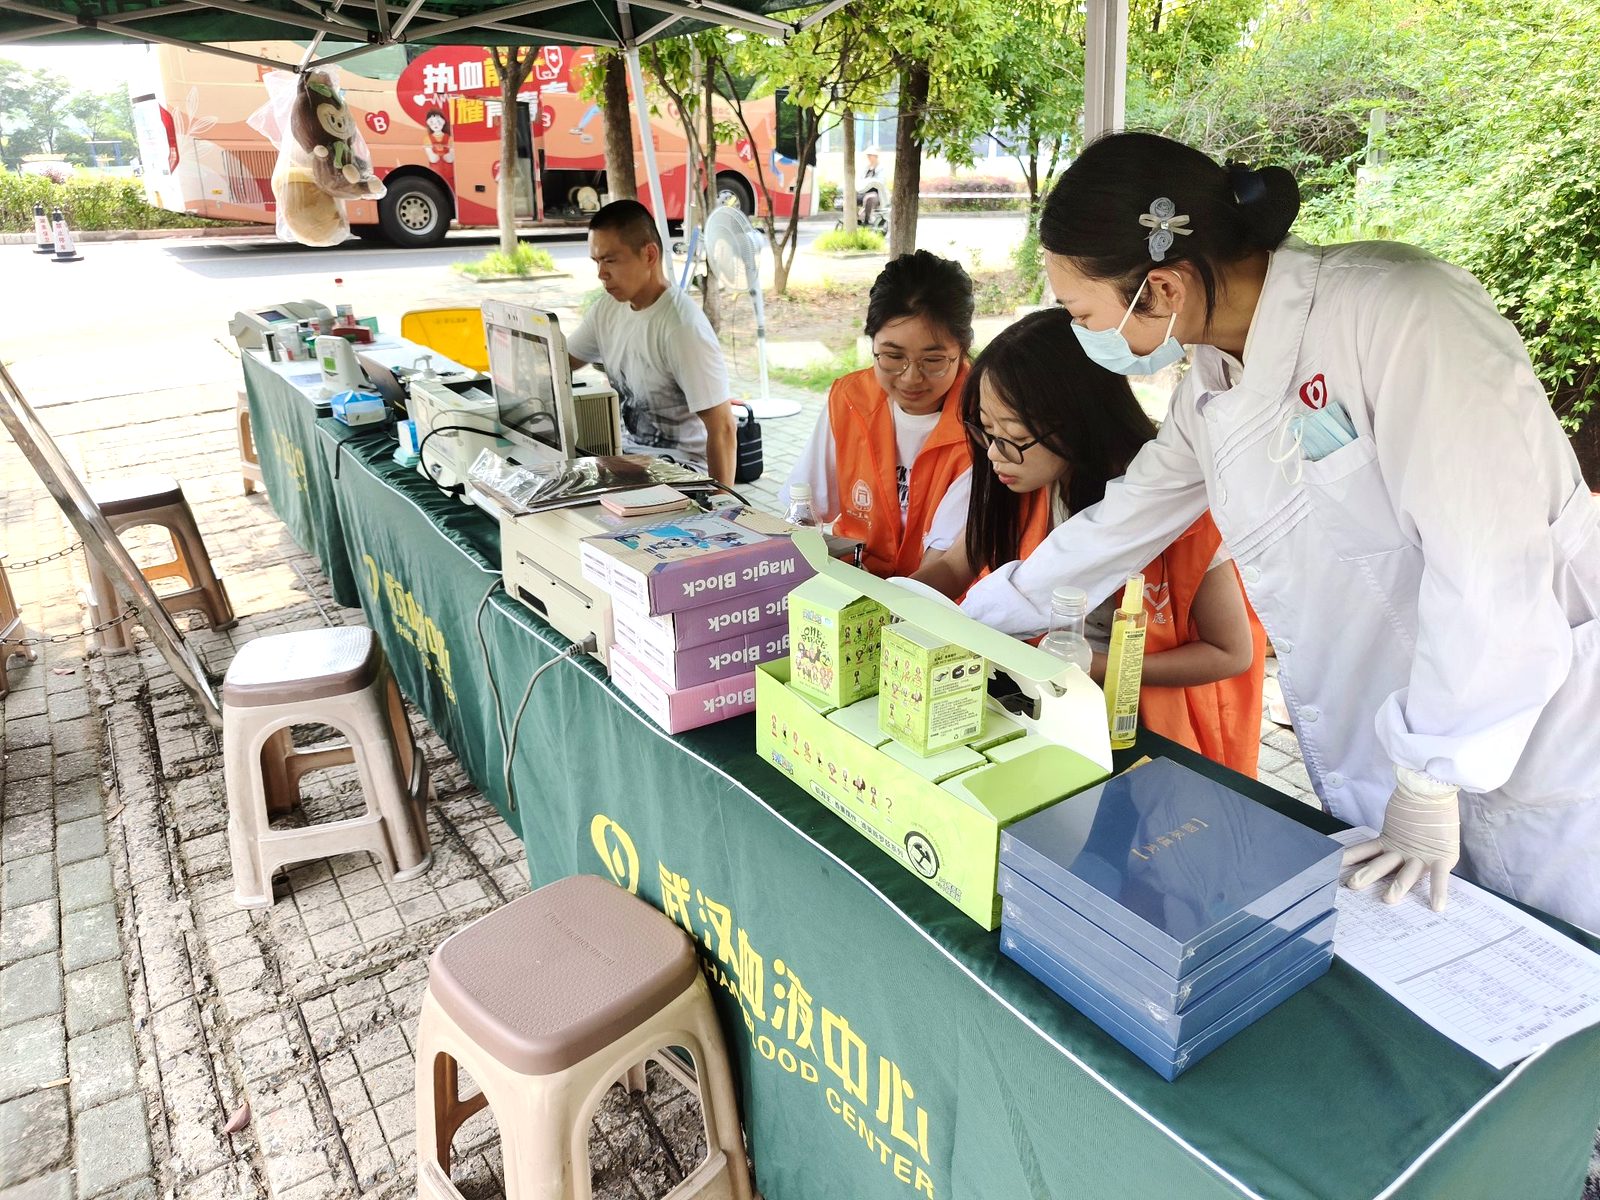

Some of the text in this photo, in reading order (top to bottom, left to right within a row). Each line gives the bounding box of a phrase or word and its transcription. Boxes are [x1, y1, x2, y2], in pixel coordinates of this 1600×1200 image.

[374, 115, 387, 133] B
[739, 143, 753, 161] A
[683, 558, 795, 597] Magic Block
[708, 607, 760, 632] Block
[708, 646, 760, 671] Block
[704, 688, 755, 713] Block
[658, 859, 931, 1166] 武汉血液中心
[825, 1087, 935, 1200] CENTER
